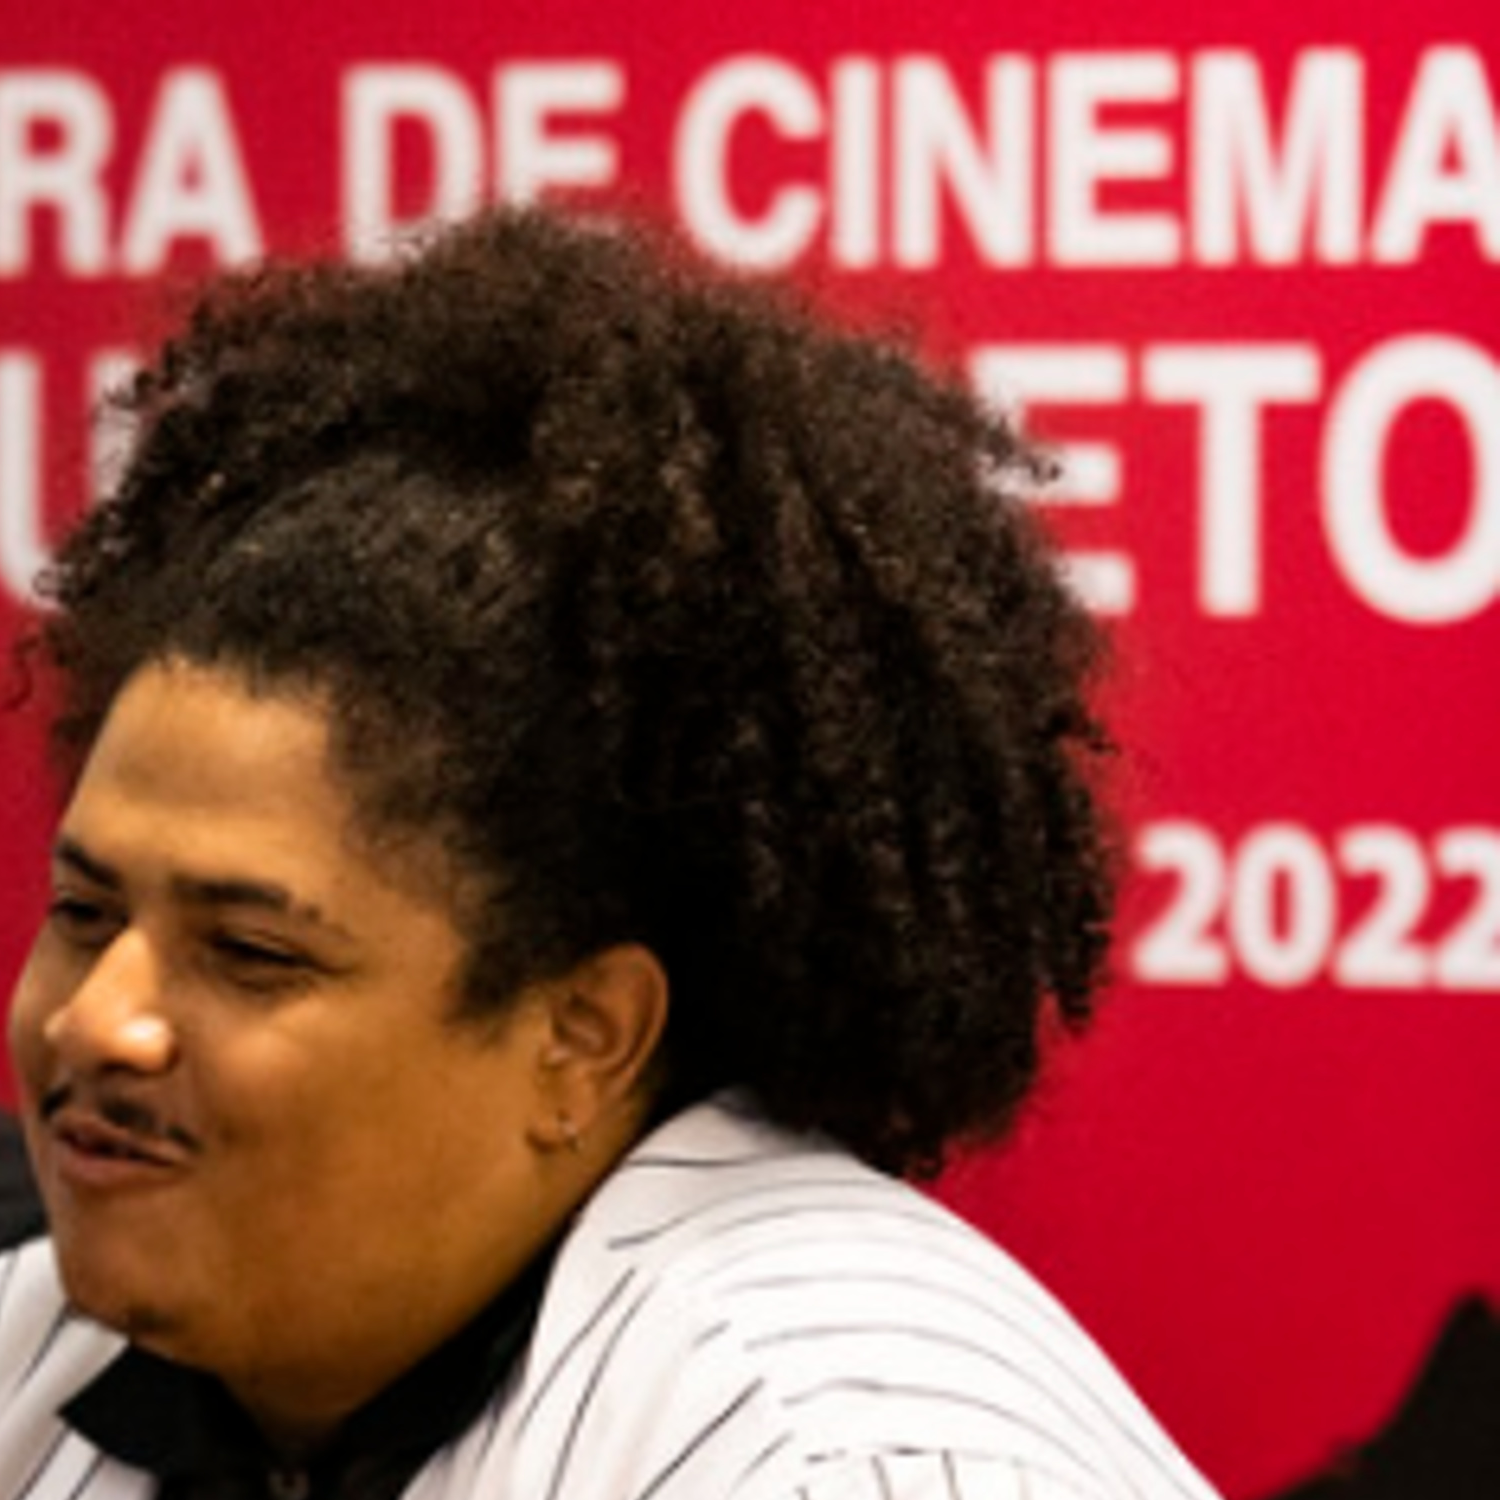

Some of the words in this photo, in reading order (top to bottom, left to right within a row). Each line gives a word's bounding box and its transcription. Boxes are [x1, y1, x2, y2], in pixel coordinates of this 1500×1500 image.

[342, 60, 624, 266] DE
[674, 46, 1500, 272] CINEMA
[972, 334, 1500, 625] ETO
[1132, 822, 1500, 990] 2022
